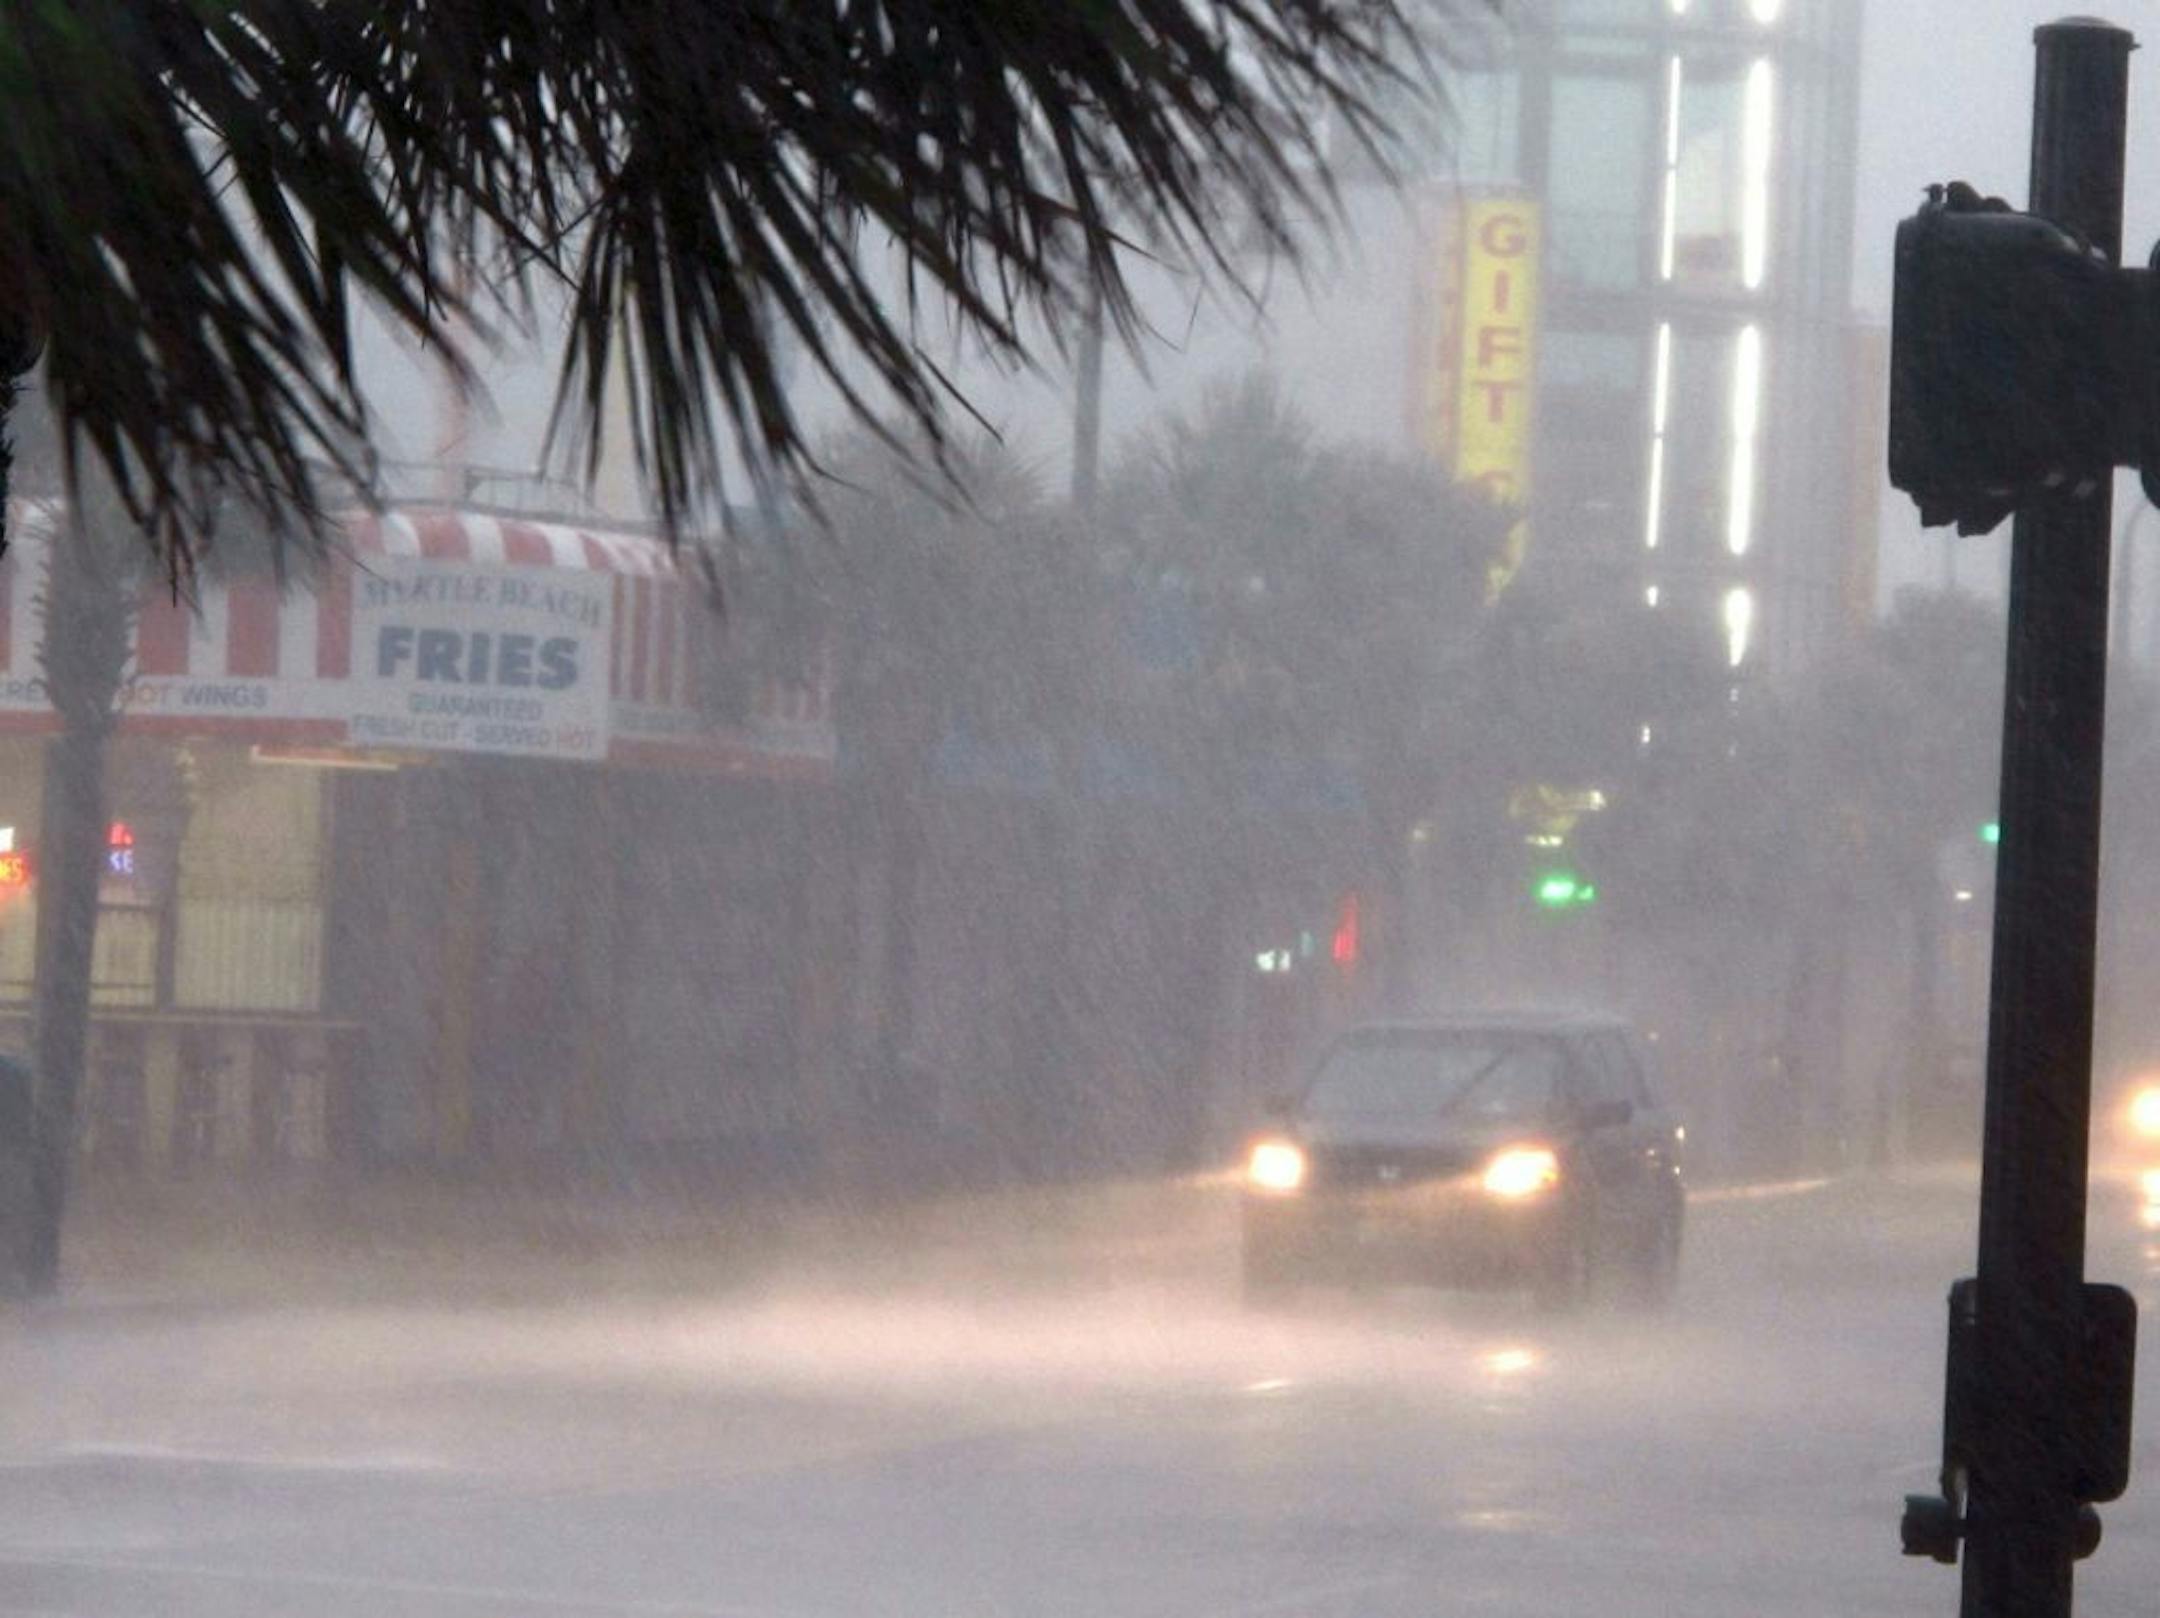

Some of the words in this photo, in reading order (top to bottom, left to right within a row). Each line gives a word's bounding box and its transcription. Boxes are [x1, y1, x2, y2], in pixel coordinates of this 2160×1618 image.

[1475, 212, 1528, 425] GIFT
[363, 573, 494, 607] MYRTLE
[498, 574, 602, 628] BEACH
[376, 624, 581, 691] FRIES
[181, 683, 269, 709] WINGS
[409, 692, 544, 722] GUARANTEED
[420, 719, 460, 742] CUT
[474, 722, 552, 748] SERVED
[556, 724, 597, 750] HOT
